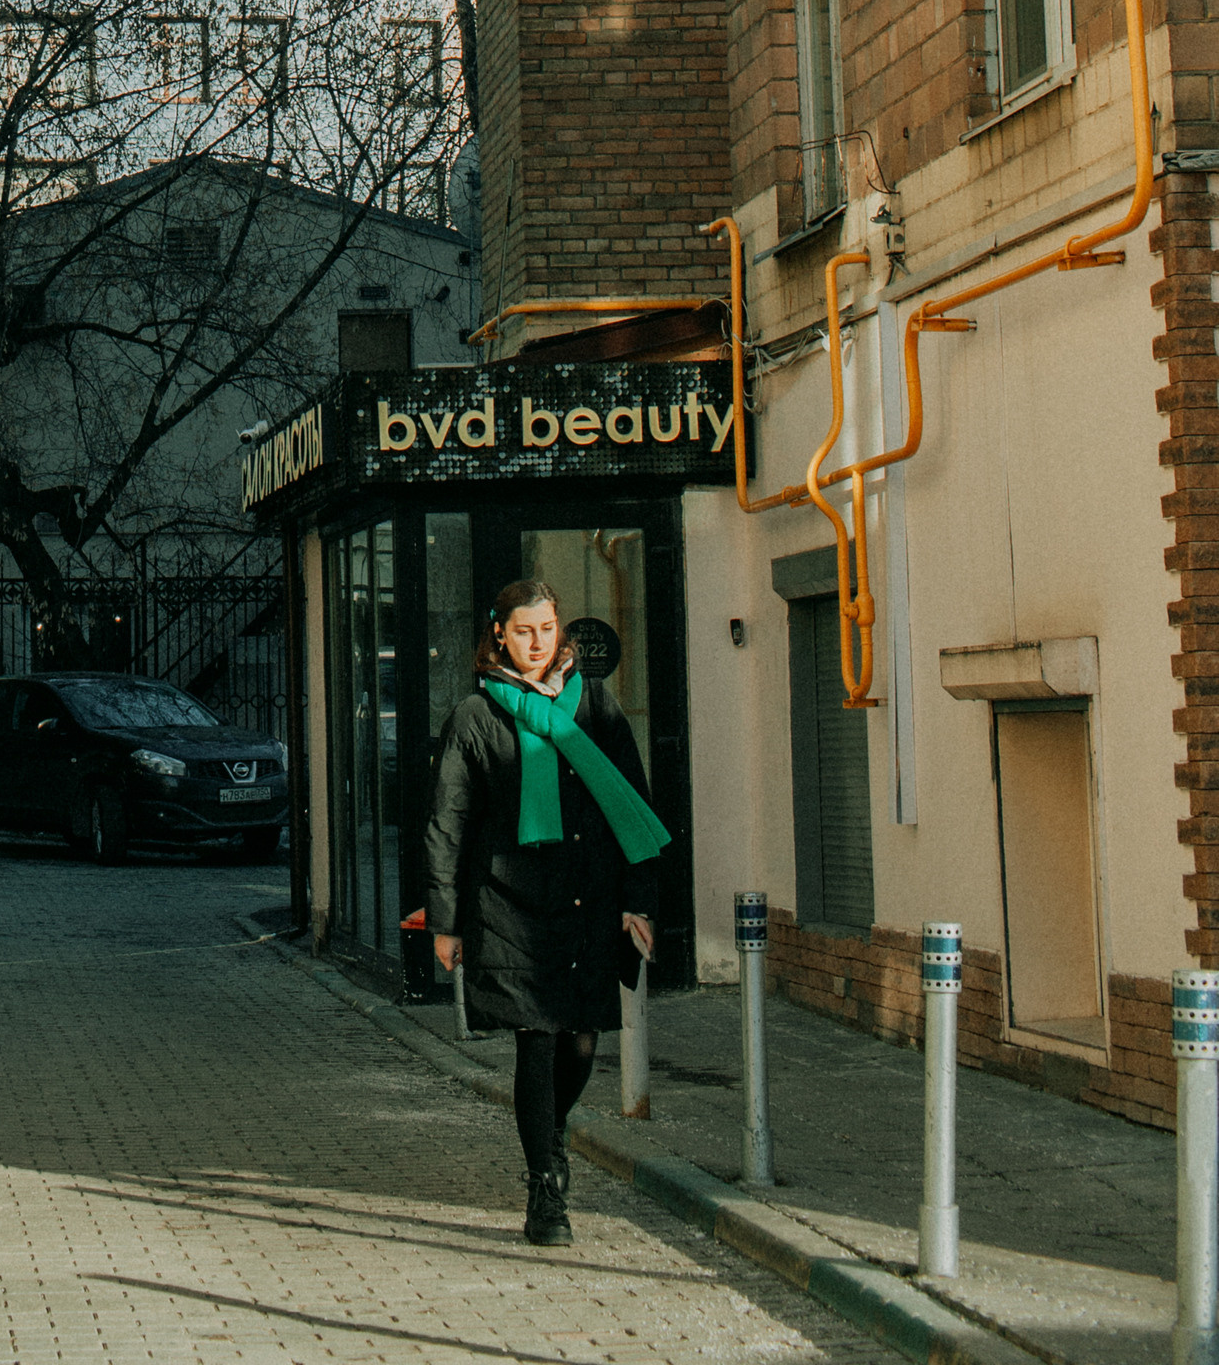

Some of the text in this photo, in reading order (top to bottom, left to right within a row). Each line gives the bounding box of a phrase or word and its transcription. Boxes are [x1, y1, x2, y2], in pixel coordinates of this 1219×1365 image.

[377, 391, 735, 453] bvd beauty
[241, 403, 323, 513] САЛОН КРАСОТЫ
[576, 643, 608, 658] 0/22
